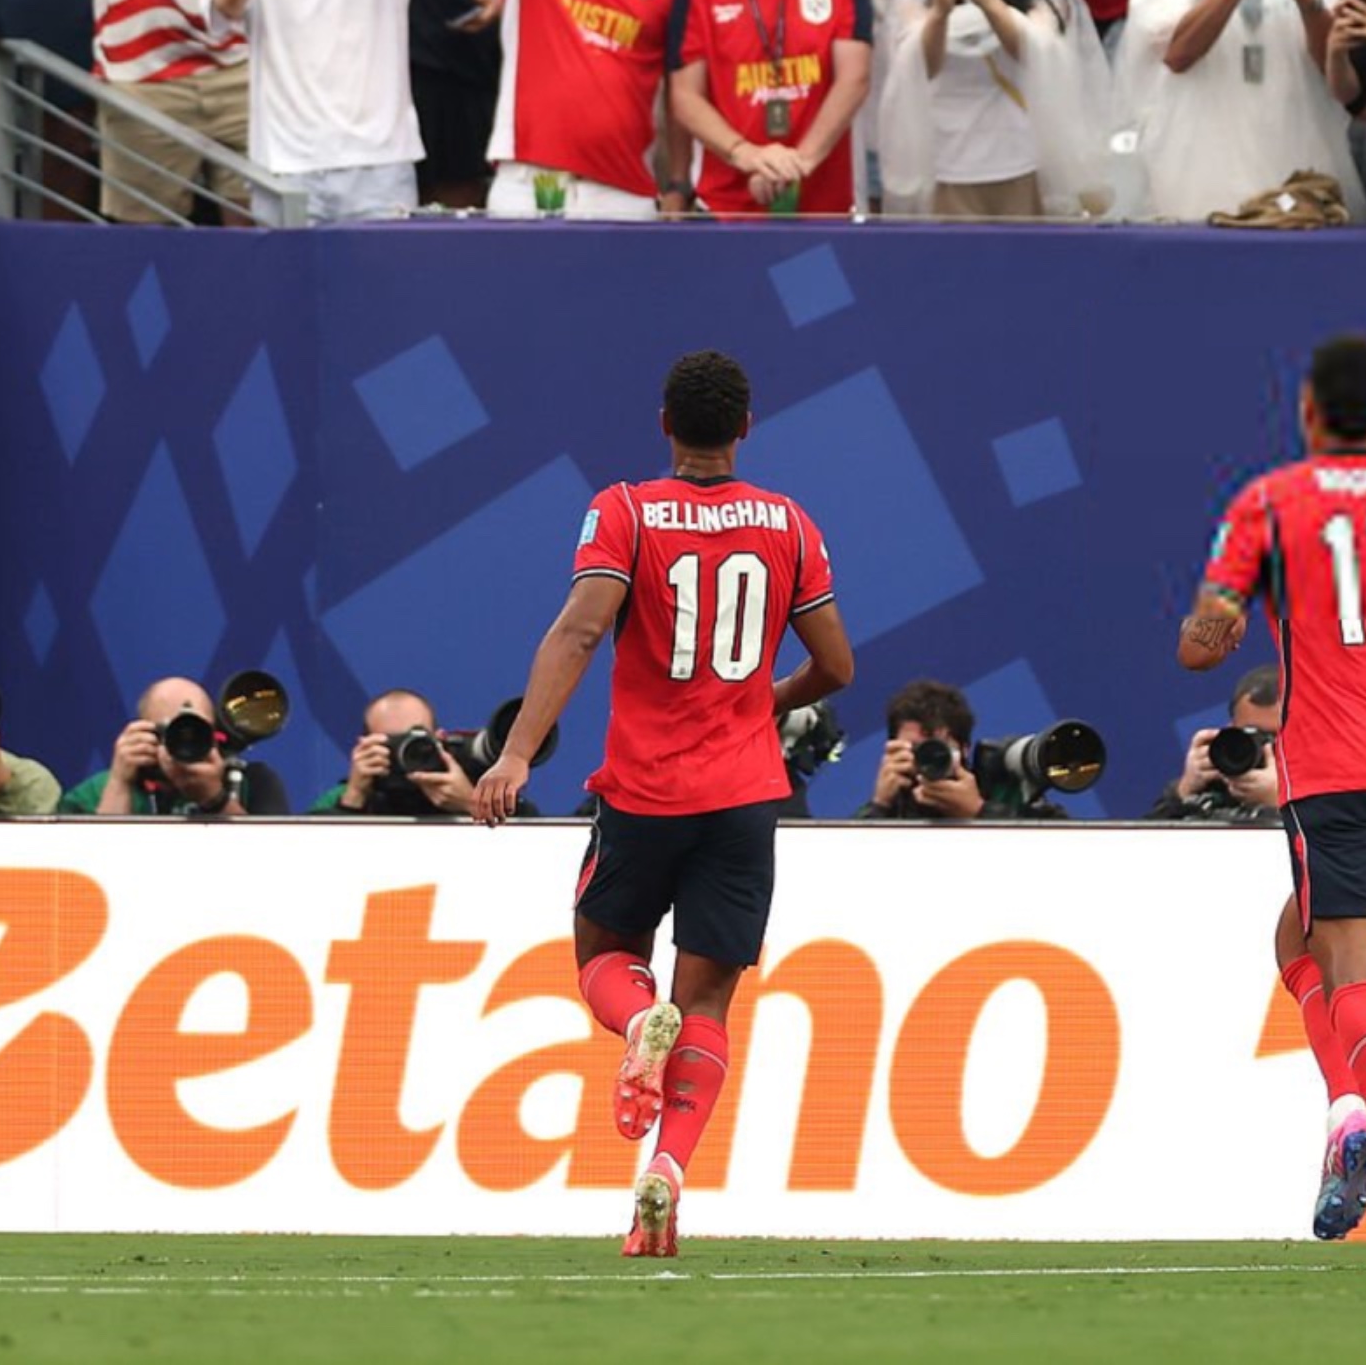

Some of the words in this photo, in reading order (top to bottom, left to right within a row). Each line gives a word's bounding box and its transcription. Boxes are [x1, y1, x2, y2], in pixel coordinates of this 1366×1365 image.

[736, 53, 822, 97] AUSTIN
[642, 500, 788, 533] BELLINGHAM
[667, 551, 769, 683] 10
